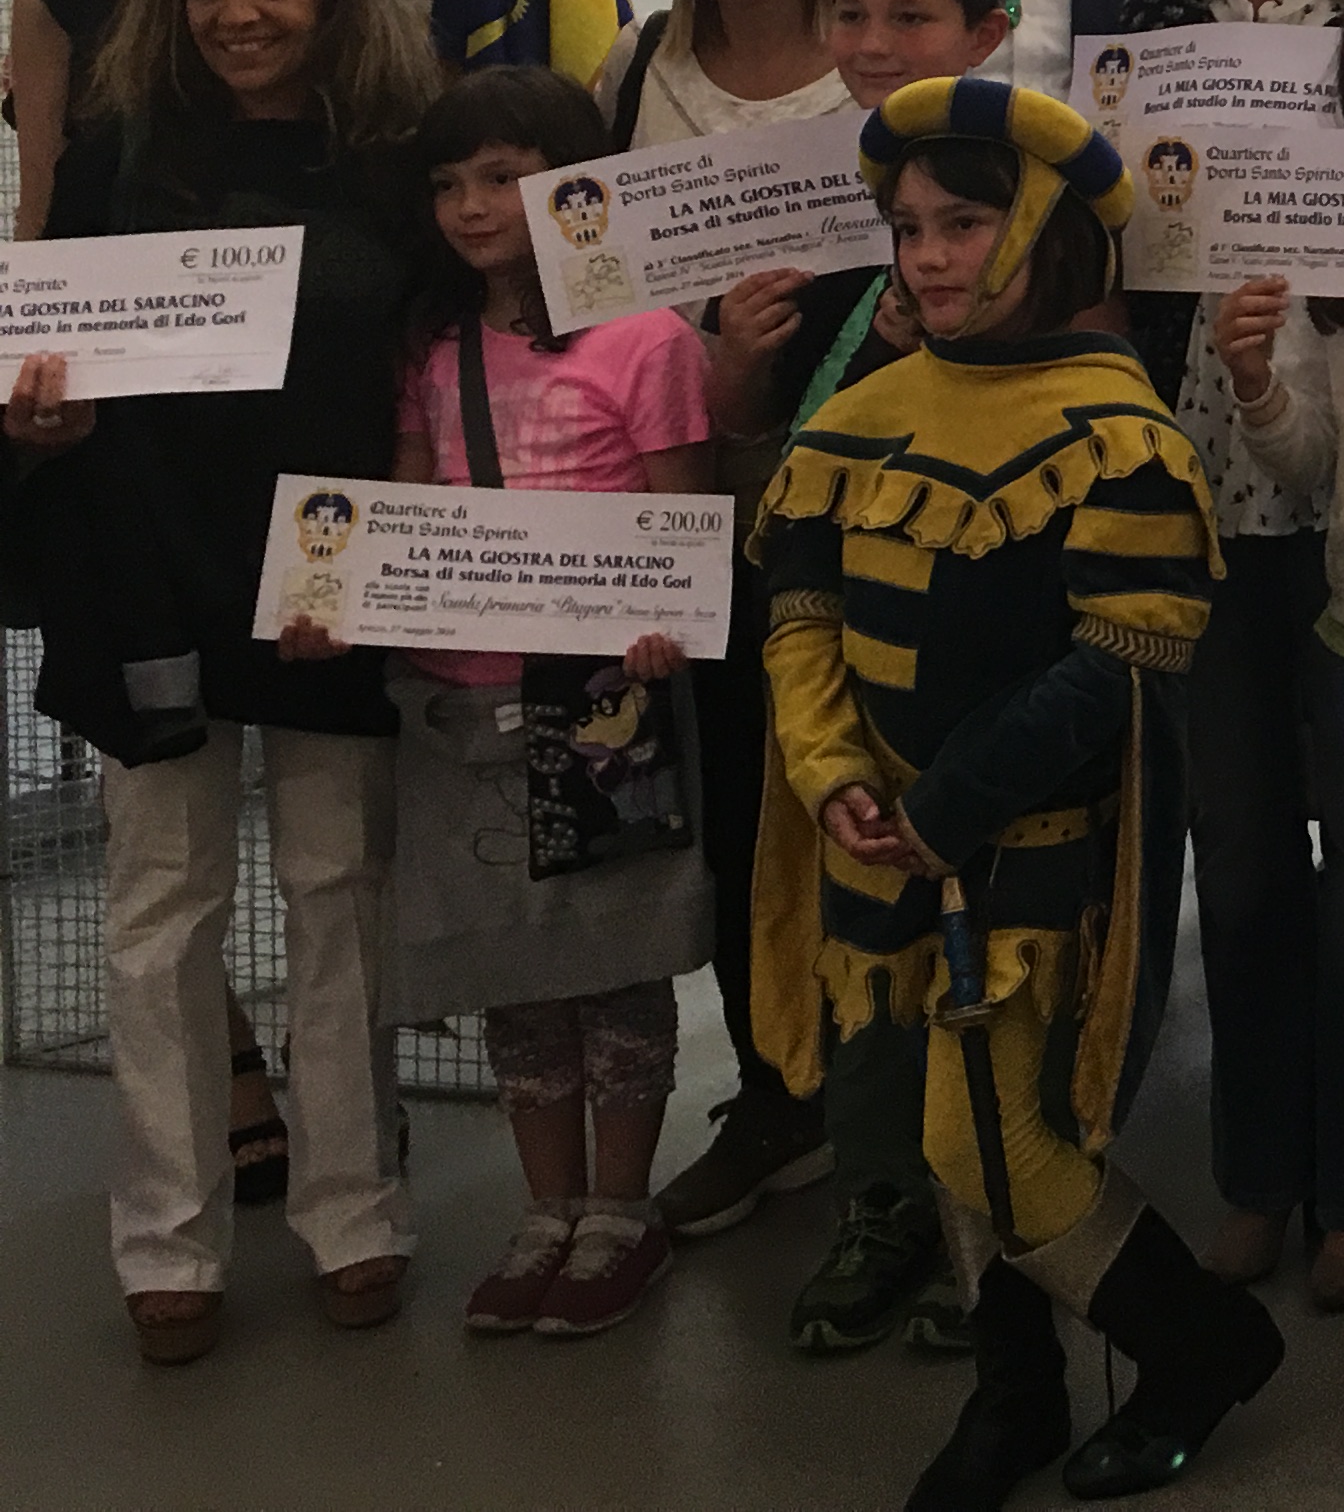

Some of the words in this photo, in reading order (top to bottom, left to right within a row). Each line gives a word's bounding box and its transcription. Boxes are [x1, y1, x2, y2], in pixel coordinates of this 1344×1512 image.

[1202, 78, 1264, 92] GIOSTRA
[1269, 80, 1298, 94] DEL
[1186, 94, 1228, 108] studio
[1250, 99, 1316, 112] memoria
[669, 203, 694, 219] LA
[699, 194, 736, 212] MIA
[740, 179, 816, 203] GIOSTRA
[820, 173, 851, 189] DEL
[1243, 191, 1262, 205] LA
[1267, 191, 1297, 206] MIA
[20, 300, 93, 317] GIOSTRA
[99, 299, 127, 313] DEL
[134, 293, 225, 311] SARACINO
[408, 547, 431, 561] LA
[437, 548, 473, 563] MIA
[480, 550, 554, 566] GIOSTRA
[559, 553, 587, 568] DEL
[594, 554, 675, 570] SARACINO
